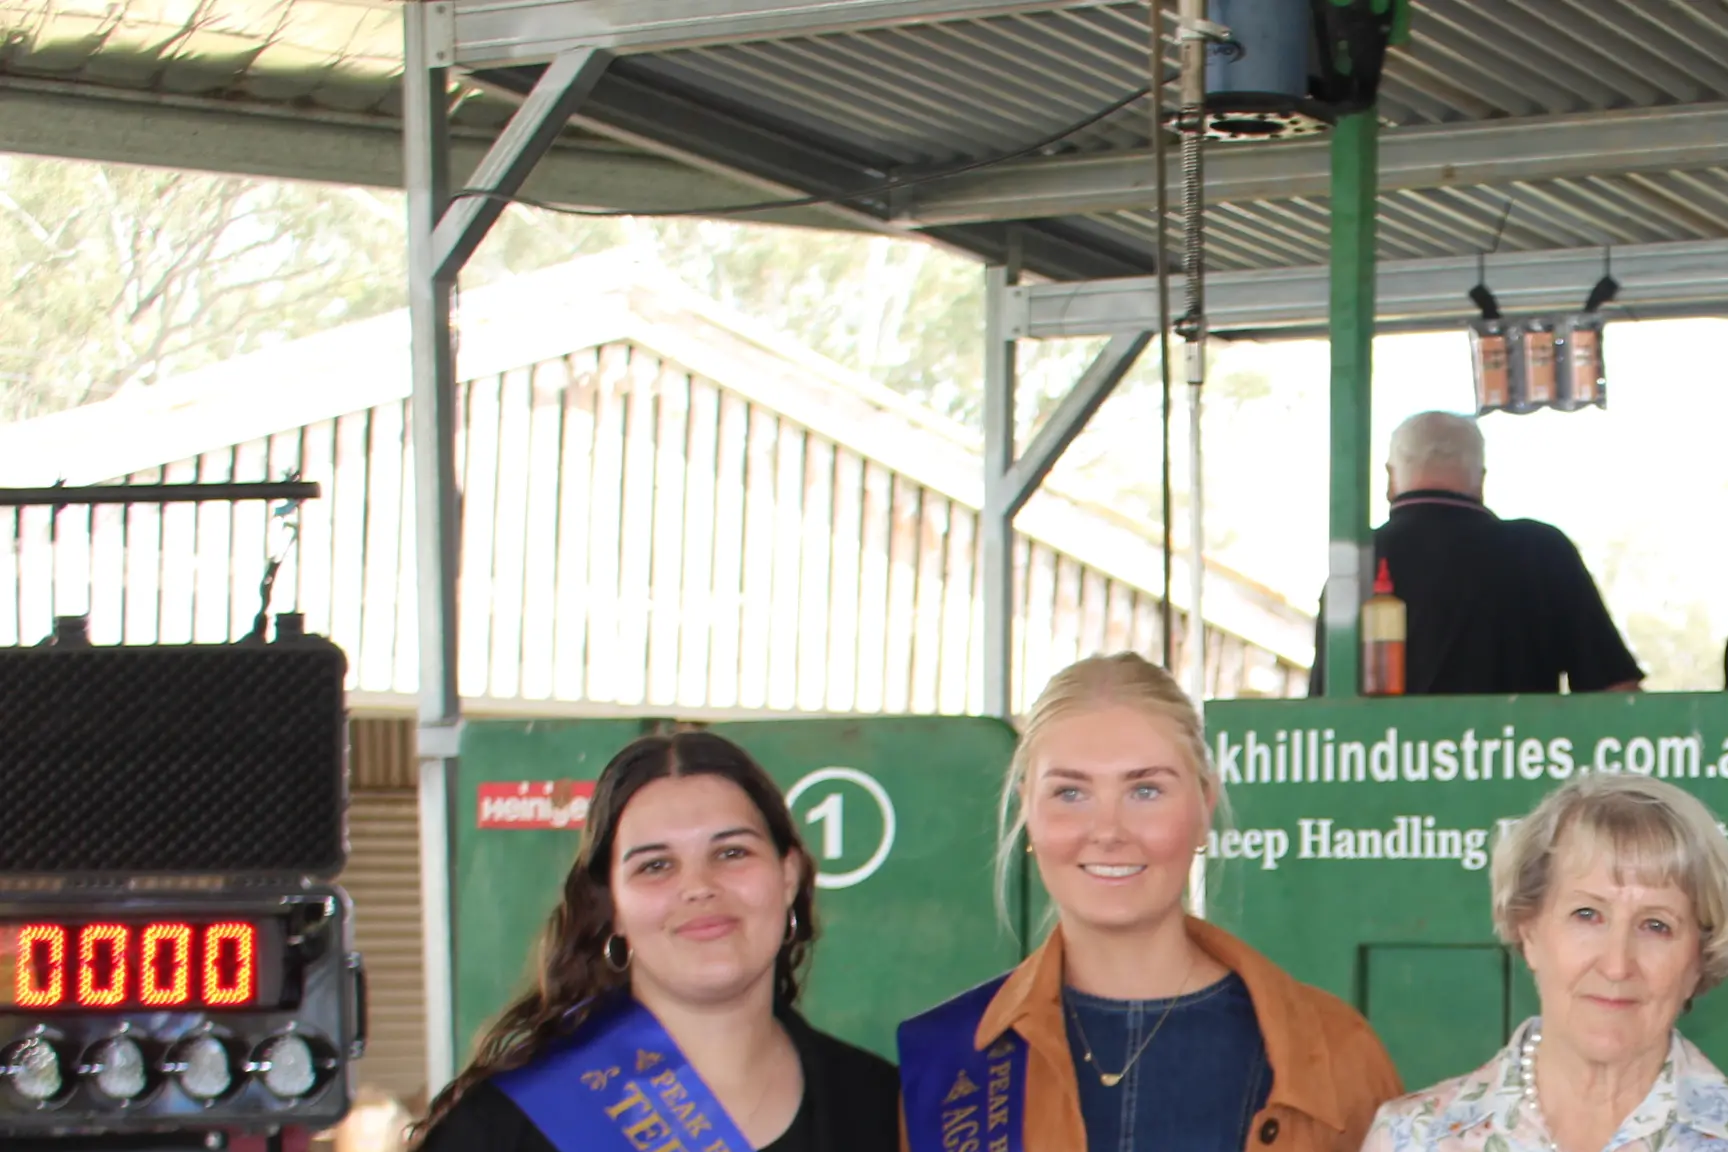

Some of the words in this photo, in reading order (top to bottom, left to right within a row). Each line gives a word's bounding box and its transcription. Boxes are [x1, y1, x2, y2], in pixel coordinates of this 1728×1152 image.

[806, 794, 843, 860] 1
[1296, 816, 1489, 870] Handling
[651, 1068, 713, 1139] PEAK
[987, 1059, 1012, 1134] PEAK
